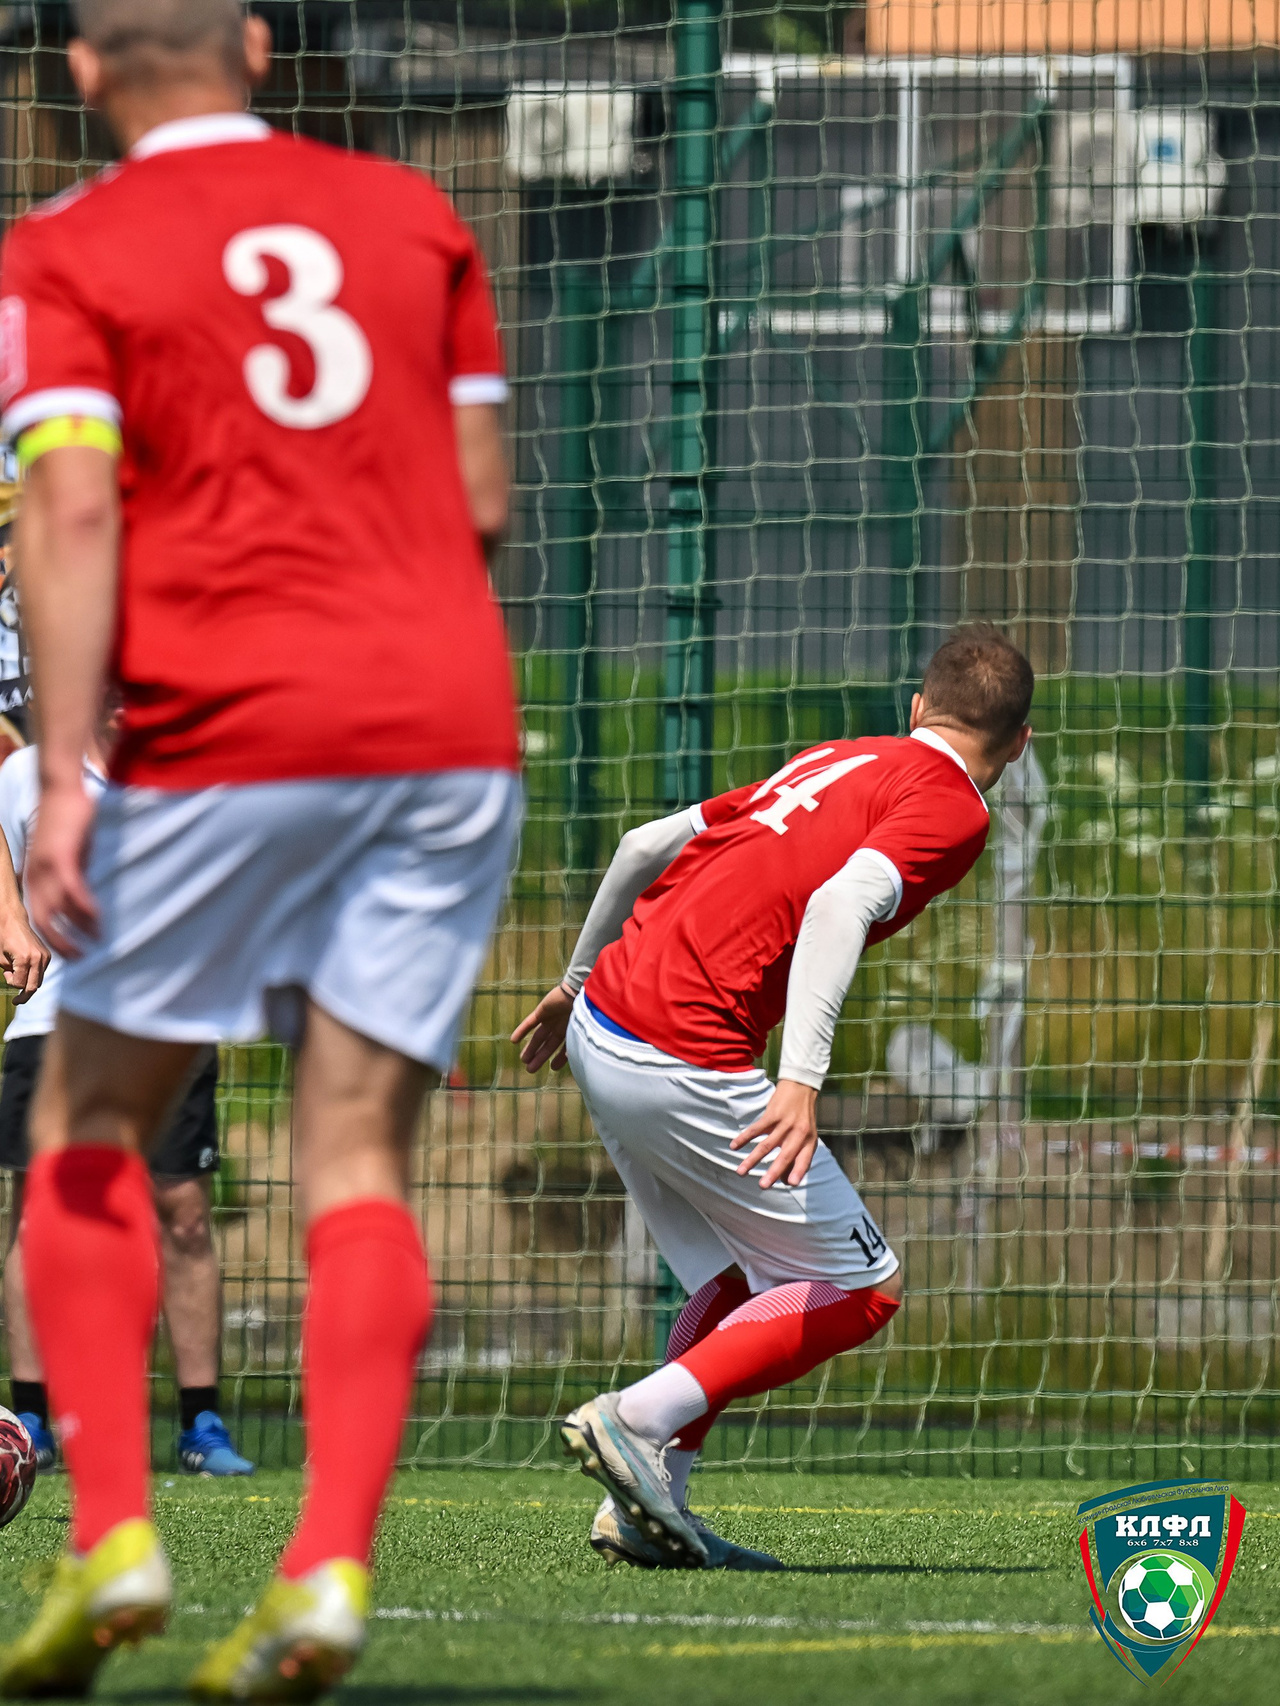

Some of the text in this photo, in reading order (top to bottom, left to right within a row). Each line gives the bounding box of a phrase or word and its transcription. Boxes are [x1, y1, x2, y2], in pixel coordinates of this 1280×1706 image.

[222, 223, 374, 430] 3
[748, 747, 879, 836] 14
[849, 1215, 887, 1268] 14
